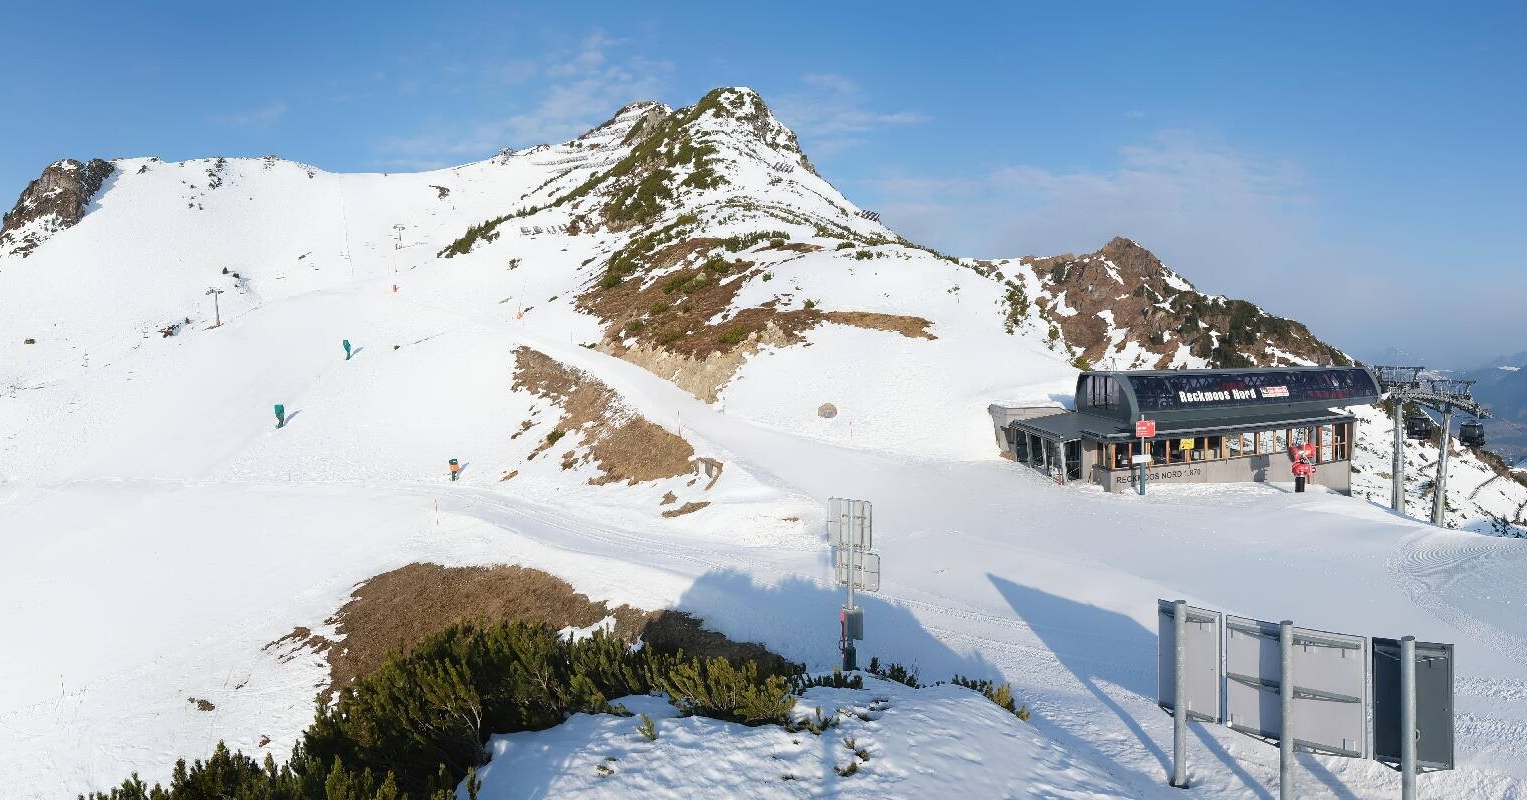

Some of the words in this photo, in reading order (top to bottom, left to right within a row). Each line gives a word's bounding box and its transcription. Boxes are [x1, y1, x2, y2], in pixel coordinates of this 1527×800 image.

[1178, 390, 1231, 403] Reckmoos
[1232, 388, 1257, 400] Nord
[1117, 473, 1160, 484] RECKOOS
[1162, 470, 1182, 480] NORD
